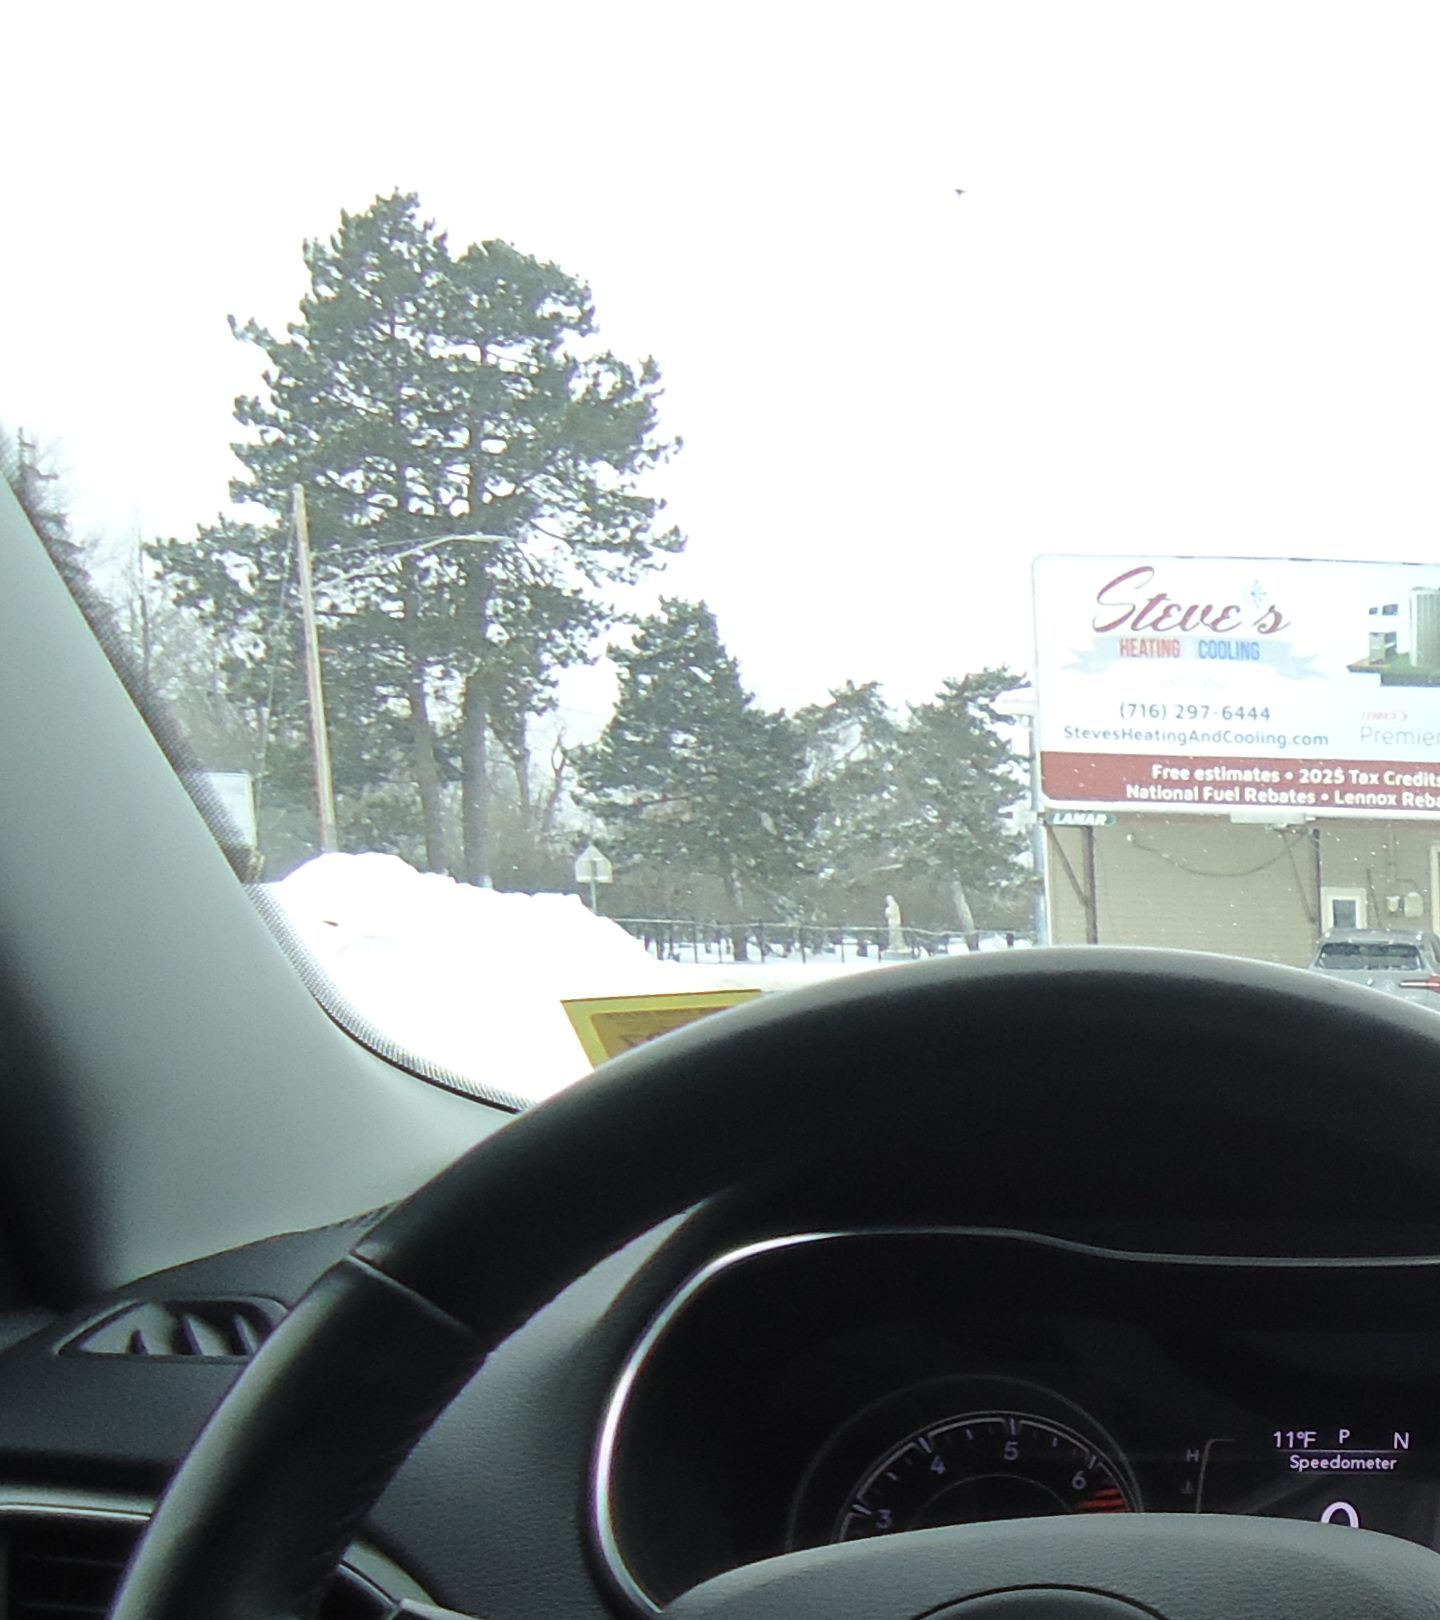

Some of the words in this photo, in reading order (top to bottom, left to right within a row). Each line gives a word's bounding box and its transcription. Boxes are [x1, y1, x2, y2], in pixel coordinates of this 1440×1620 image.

[1092, 565, 1291, 634] Steve's
[1119, 638, 1181, 659] HEATING
[1198, 639, 1261, 661] COOLING
[1119, 702, 1168, 720] (716)
[1175, 704, 1271, 721] 297-6444
[1064, 725, 1329, 749] StevesHeatingAndCooling.com
[1152, 765, 1190, 781] Free
[1194, 766, 1280, 783] estimates
[1299, 768, 1345, 785] 2025
[1349, 770, 1379, 785] Tax
[1126, 784, 1199, 801] National
[1203, 786, 1240, 802] Fuel
[1244, 788, 1316, 804] Rebates
[1334, 790, 1398, 806] Lennox
[1053, 813, 1107, 827] LAMAR
[1272, 1430, 1318, 1449] 11°F
[1338, 1428, 1351, 1445] P
[1393, 1431, 1411, 1450] N
[1004, 1440, 1019, 1461] 5
[929, 1455, 947, 1476] 4
[1289, 1453, 1399, 1473] Speedometer
[1071, 1471, 1087, 1490] 6
[876, 1508, 893, 1530] 3
